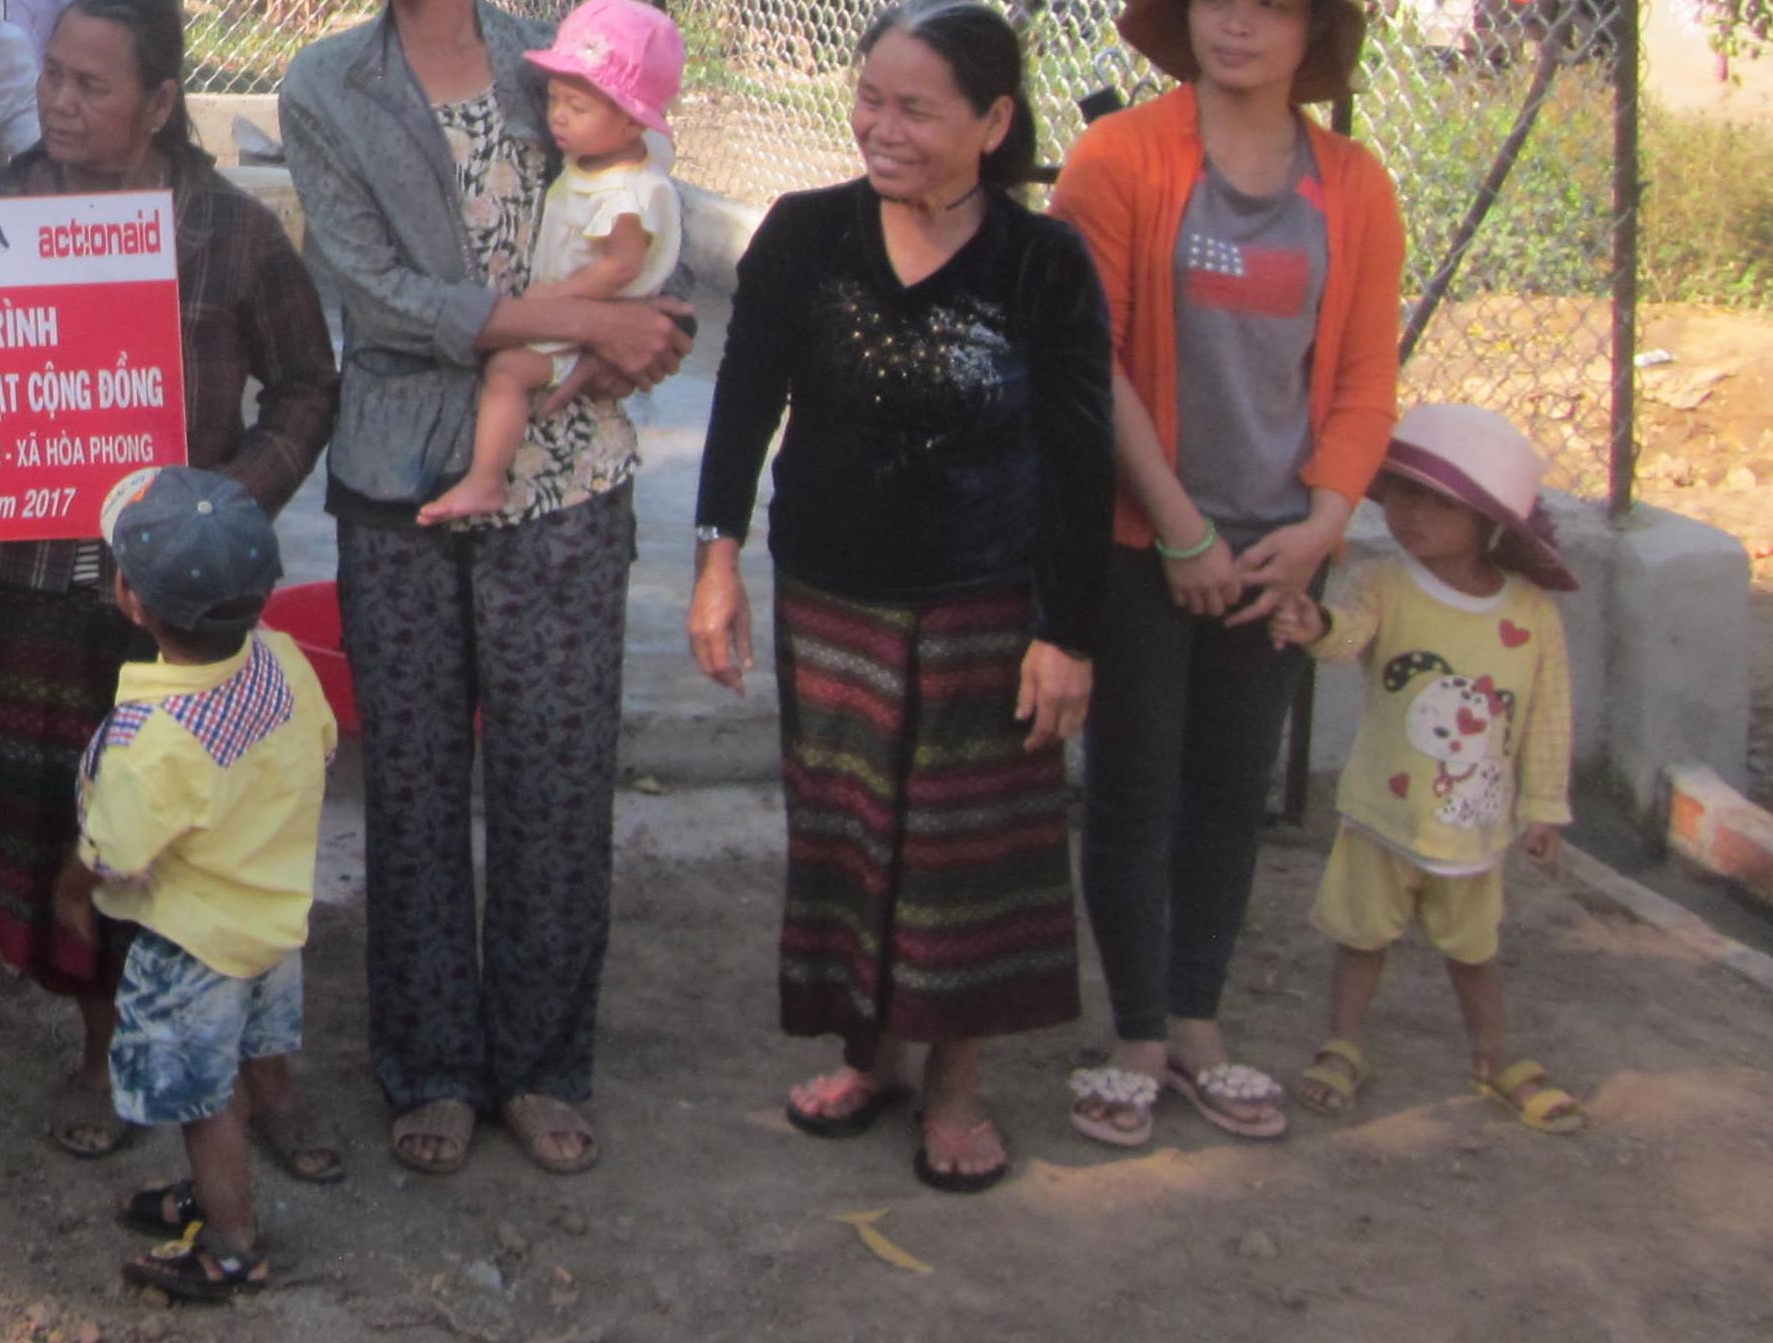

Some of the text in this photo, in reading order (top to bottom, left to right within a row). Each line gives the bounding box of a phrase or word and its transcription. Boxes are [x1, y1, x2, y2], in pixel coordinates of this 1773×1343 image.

[28, 360, 92, 419] CỘNG
[98, 350, 164, 409] ĐỒNG
[16, 431, 41, 468] XÃ
[46, 429, 84, 466] HÒA
[89, 433, 154, 464] PHONG
[22, 487, 76, 518] 2017
